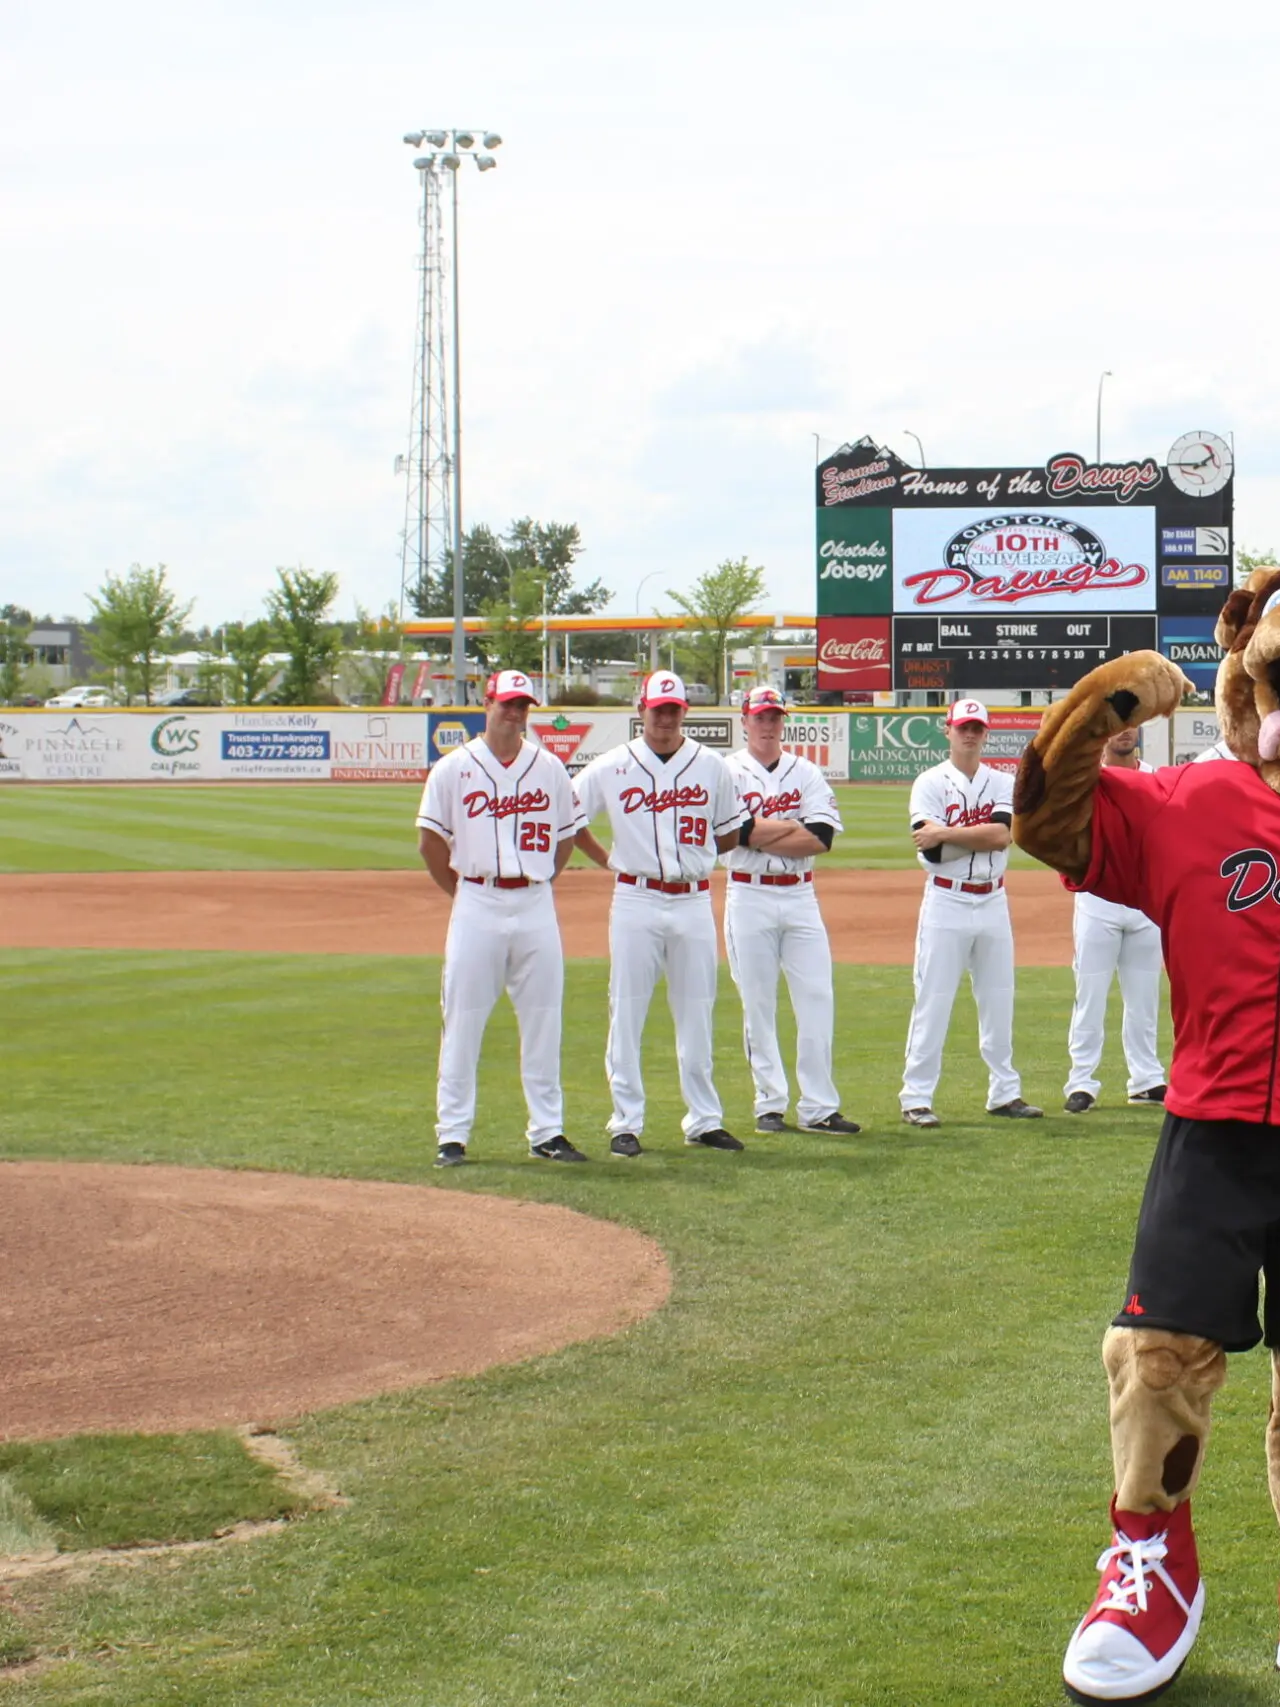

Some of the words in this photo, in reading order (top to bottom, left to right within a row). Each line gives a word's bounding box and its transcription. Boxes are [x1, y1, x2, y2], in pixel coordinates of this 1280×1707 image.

[822, 460, 890, 488] Seaman
[900, 471, 968, 495] Home
[976, 472, 1001, 500] of
[1007, 470, 1042, 494] the
[1051, 457, 1157, 496] Dawgs
[824, 476, 897, 505] Stadium
[962, 515, 1078, 539] OKOTOKS
[820, 540, 887, 558] Okotoks
[995, 534, 1059, 551] 10TH
[1083, 542, 1098, 550] 17
[951, 551, 1101, 566] ANNIVERSARY
[820, 560, 887, 581] Sobeys
[1167, 569, 1189, 581] AM
[1194, 569, 1223, 581] 1140
[902, 557, 1149, 605] Dawgs
[941, 625, 971, 637] BALL
[996, 624, 1038, 636] STRIKE
[1066, 624, 1091, 636] OUT
[901, 642, 913, 652] AT
[916, 642, 934, 652] BAT
[968, 650, 973, 660] 1
[979, 650, 986, 660] 2
[991, 650, 998, 660] 3
[1002, 650, 1009, 660] 4
[1015, 650, 1022, 660] 5
[1027, 650, 1034, 660] 6
[1040, 650, 1046, 660] 7
[1052, 650, 1059, 660] 8
[1064, 650, 1070, 660] 9
[1074, 650, 1085, 660] 10
[1099, 650, 1106, 660] R
[1170, 643, 1222, 661] DASANI
[227, 734, 260, 742] Trustee
[262, 733, 271, 743] in
[439, 728, 464, 745] NAPA
[542, 734, 580, 743] CANADIAN
[873, 715, 931, 749] KC
[25, 738, 126, 751] PINNACLE
[227, 745, 325, 758] 403-777-9999
[333, 742, 423, 760] INFINITE
[462, 787, 550, 820] Dawgs
[619, 783, 709, 814] Dawgs
[519, 821, 552, 853] 25
[678, 815, 708, 847] 29
